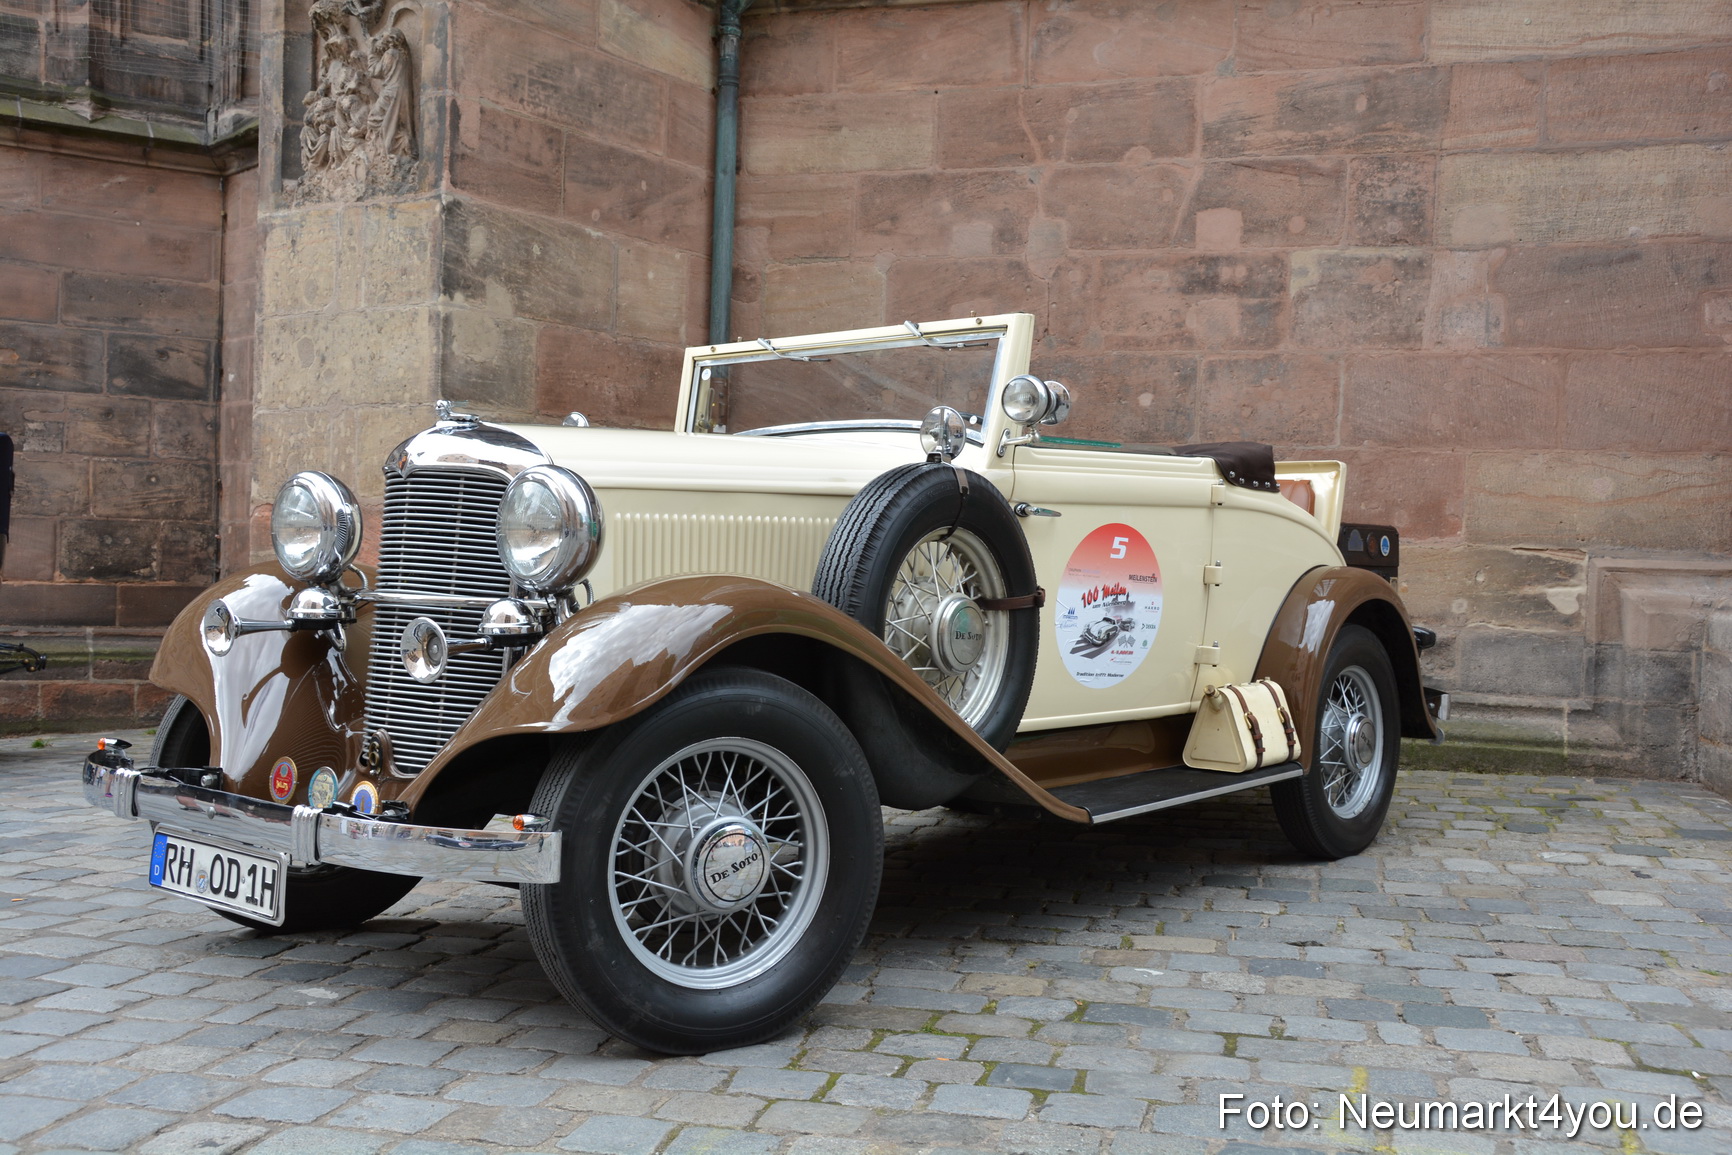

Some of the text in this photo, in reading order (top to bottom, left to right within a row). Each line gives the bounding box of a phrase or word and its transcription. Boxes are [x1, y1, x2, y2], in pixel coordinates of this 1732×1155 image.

[1109, 536, 1129, 559] 5
[1081, 582, 1127, 608] 100 Meilen
[153, 865, 160, 876] D
[162, 843, 195, 887] RH
